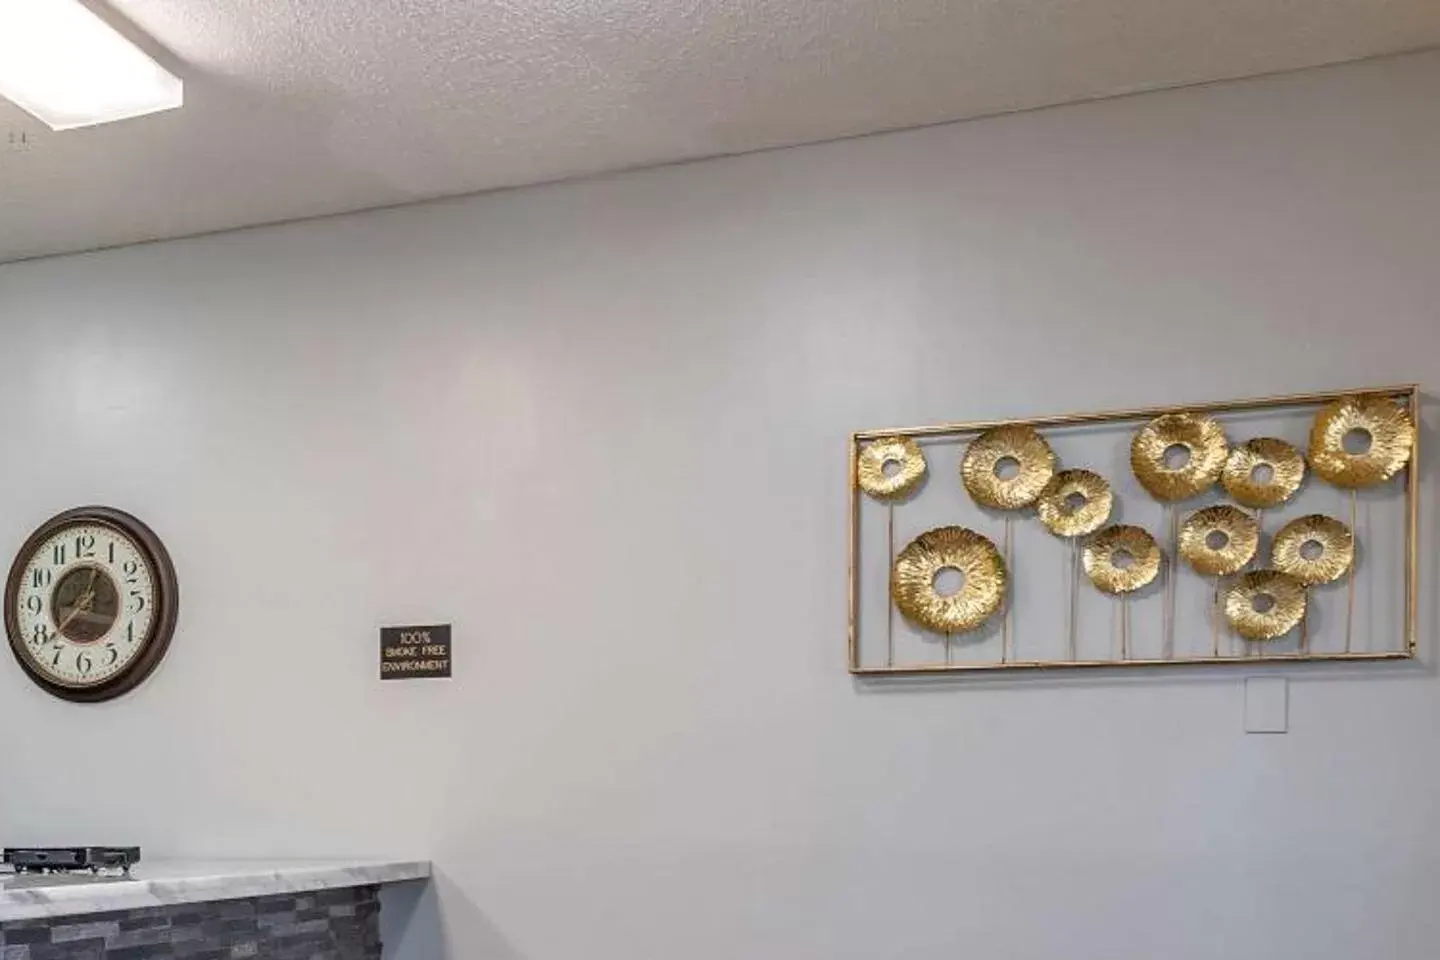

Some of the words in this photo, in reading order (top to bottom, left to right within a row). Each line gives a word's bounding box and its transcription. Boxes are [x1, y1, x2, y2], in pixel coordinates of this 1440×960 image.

[53, 544, 66, 566] 11
[75, 535, 96, 558] 12
[108, 541, 115, 564] 1
[32, 567, 52, 589] 10
[123, 561, 137, 583] 2
[26, 595, 42, 616] 9
[32, 623, 48, 646] 8
[52, 643, 65, 666] 7
[422, 644, 447, 656] FREE
[75, 651, 92, 674] 6
